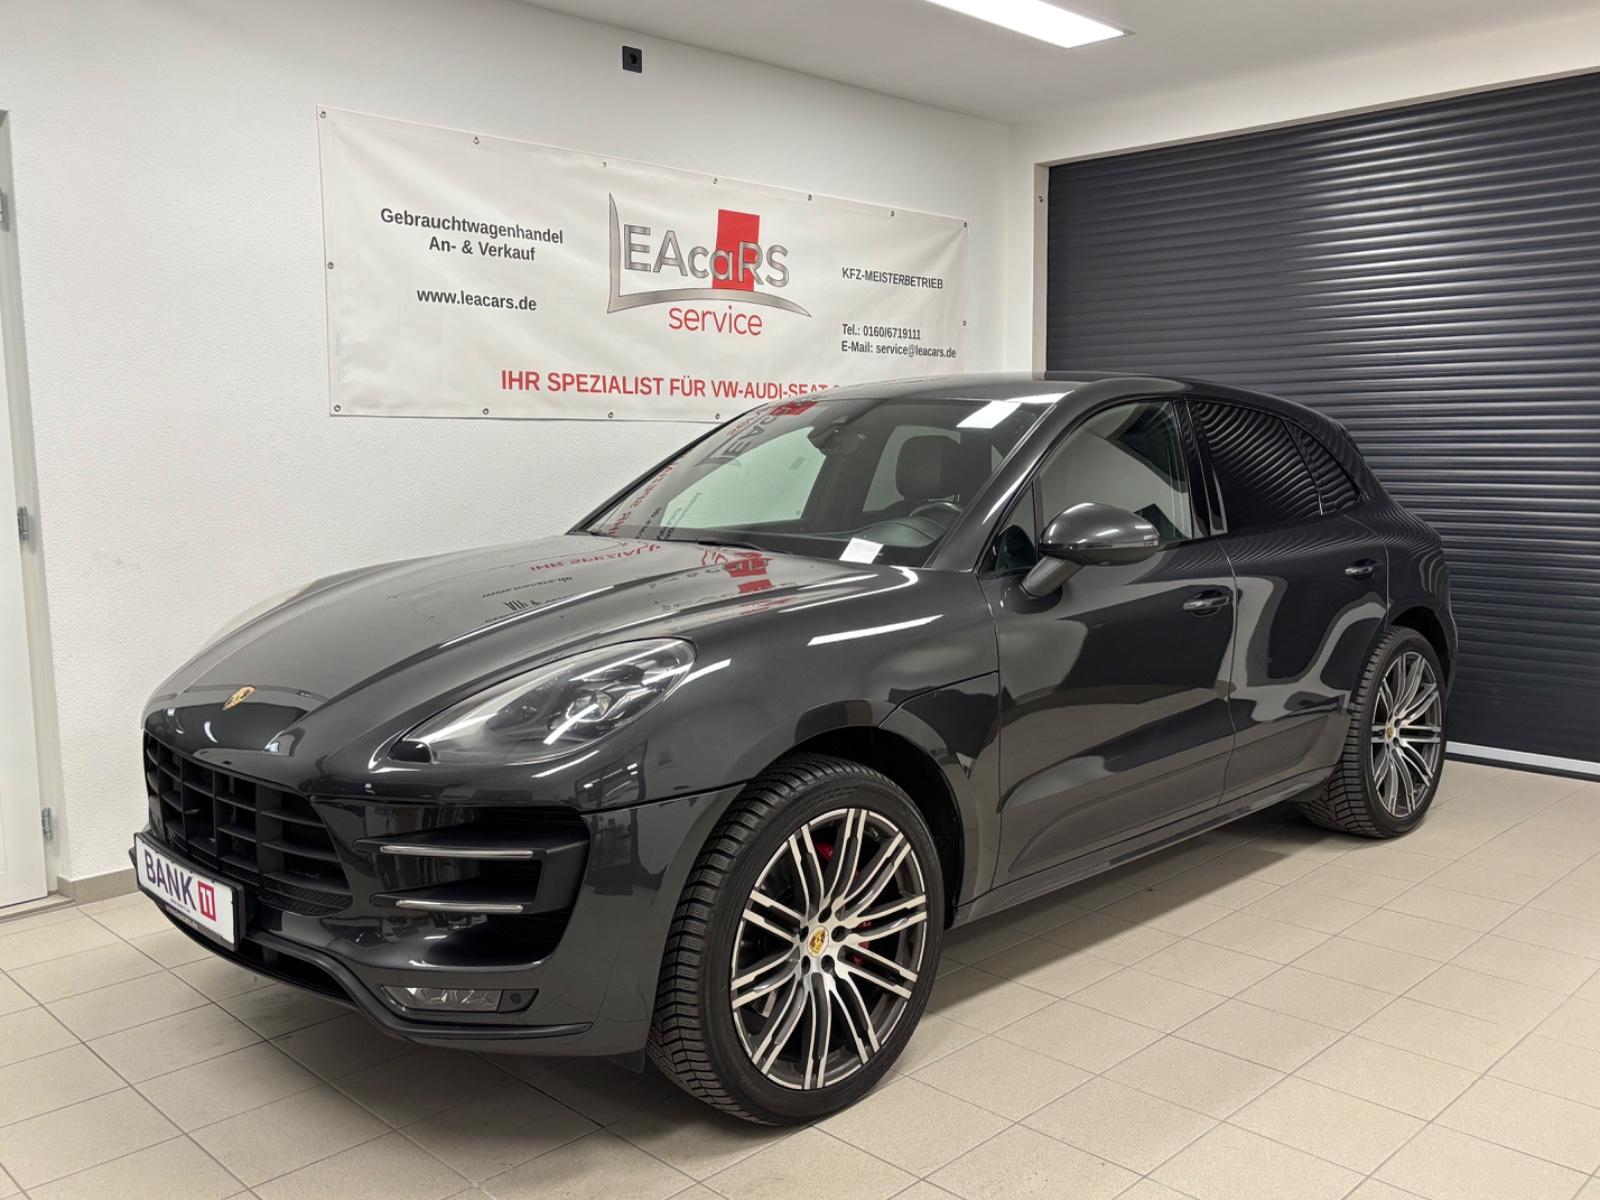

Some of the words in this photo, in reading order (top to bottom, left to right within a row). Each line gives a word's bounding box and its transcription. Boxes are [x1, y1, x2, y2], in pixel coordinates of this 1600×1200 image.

[380, 207, 564, 244] Gebrauchtwagenhandel
[428, 236, 457, 252] An-
[461, 239, 474, 255] &
[478, 241, 536, 261] Verkauf
[841, 267, 944, 290] KFZ-MEISTERBETRIEB
[416, 289, 537, 311] www.leacars.de
[668, 304, 763, 336] service
[842, 323, 861, 337] Tel.:
[862, 324, 922, 341] 0160/6719111
[840, 340, 874, 354] E-Mail:
[875, 343, 957, 359] service@leacars.de
[501, 369, 541, 392] IHR
[546, 371, 665, 396] SPEZIALIST
[669, 375, 706, 398] FÜR
[144, 848, 197, 912] BANK
